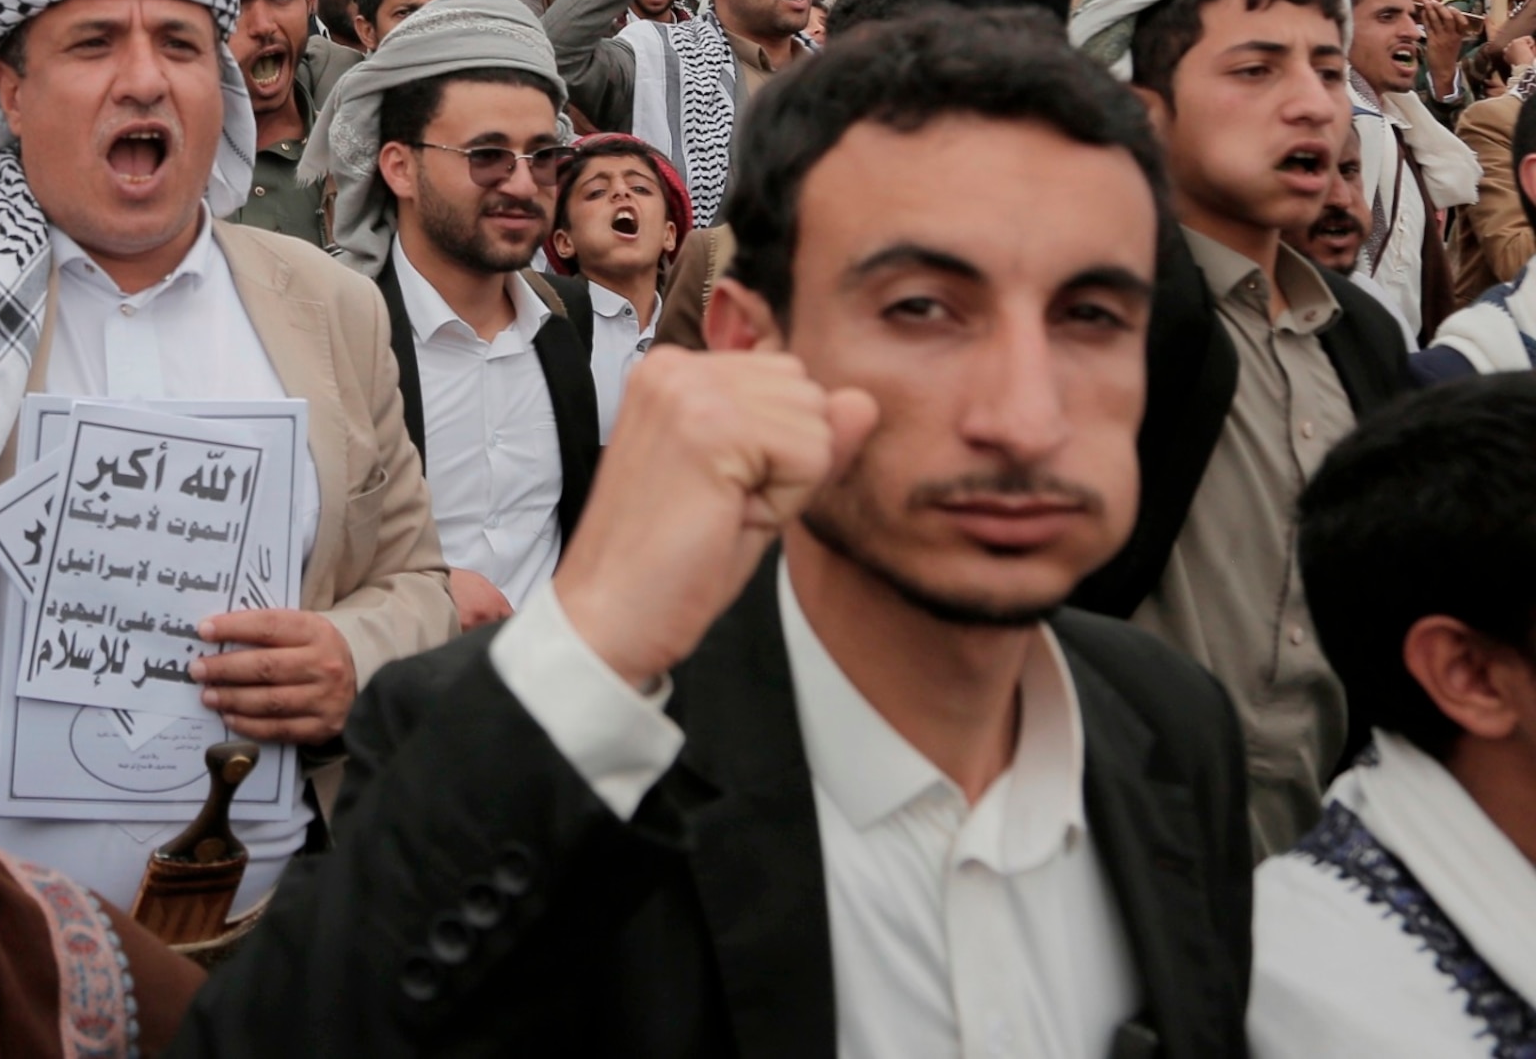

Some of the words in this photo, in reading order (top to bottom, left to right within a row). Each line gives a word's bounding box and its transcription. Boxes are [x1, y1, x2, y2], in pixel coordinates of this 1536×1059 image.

[76, 442, 168, 503] أكبر
[179, 451, 253, 505] الله
[68, 496, 161, 532] لأمريكا
[166, 518, 240, 544] الموت
[56, 548, 153, 587] لإسرائيل
[157, 566, 231, 594] الموت
[46, 599, 116, 628] اليهود
[116, 611, 156, 633] على
[36, 628, 131, 686] للإسلام
